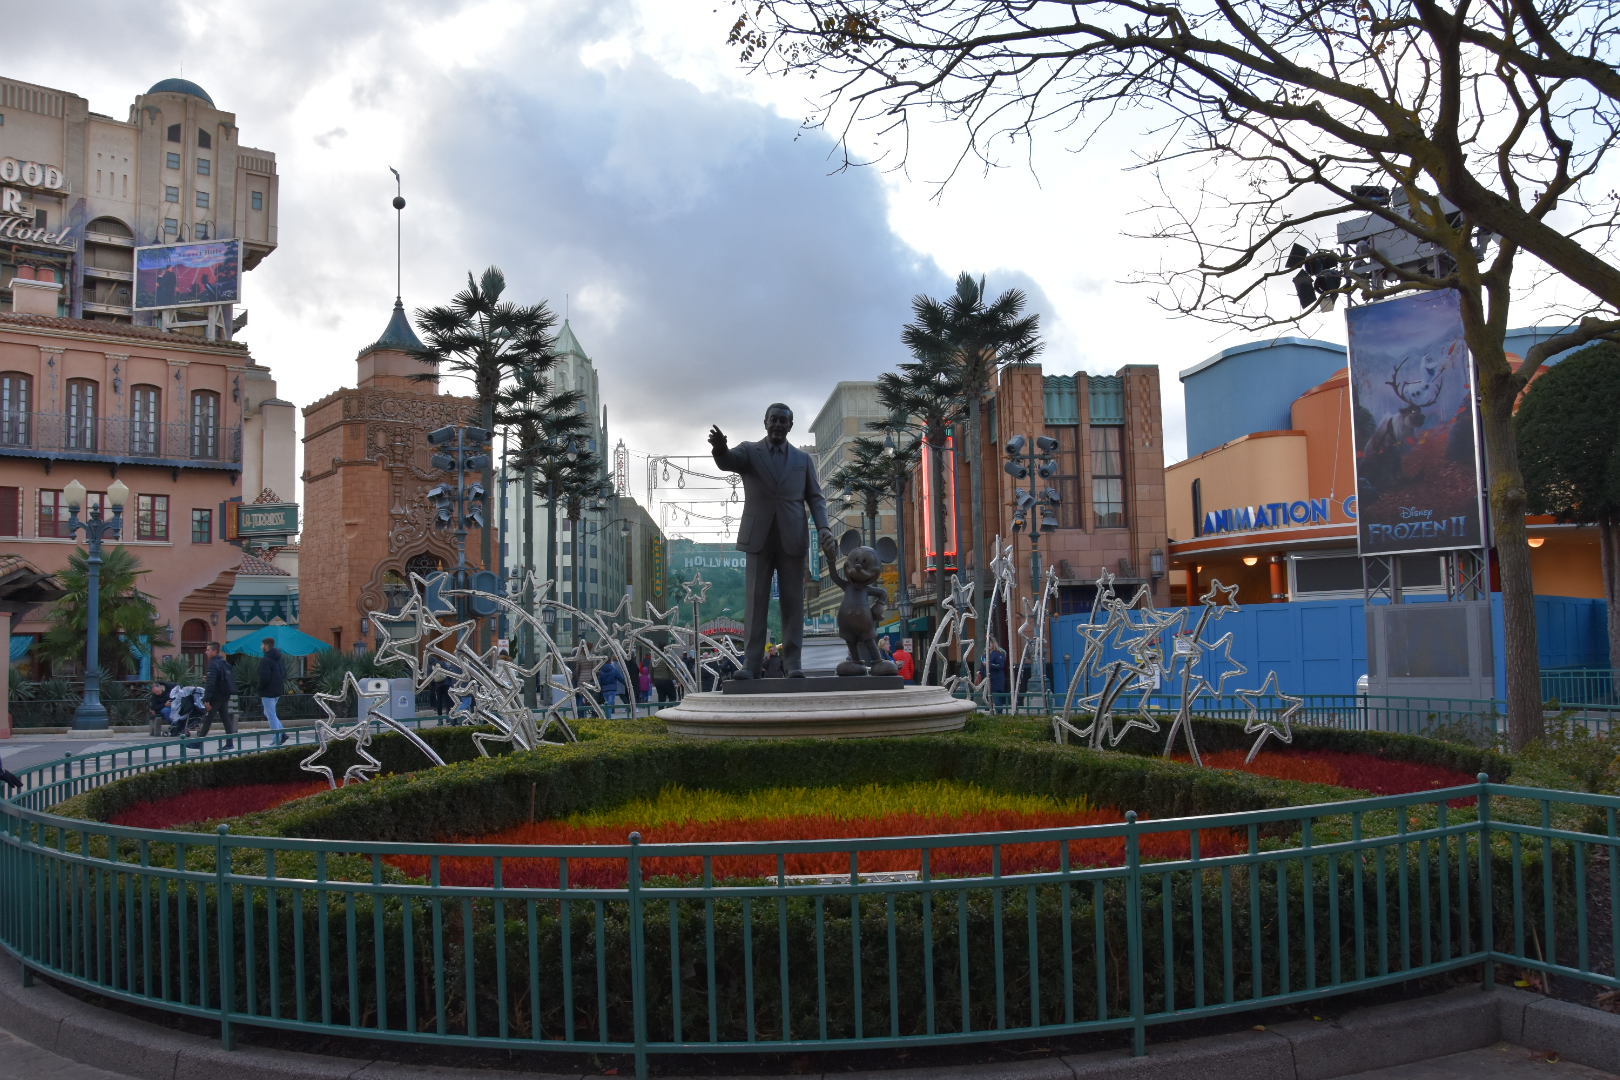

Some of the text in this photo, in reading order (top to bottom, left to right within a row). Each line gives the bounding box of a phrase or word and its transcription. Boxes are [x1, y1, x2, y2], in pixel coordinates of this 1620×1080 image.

[0, 157, 63, 190] OOD
[0, 216, 72, 245] Hotel
[1202, 497, 1331, 535] ANIMATION
[1399, 506, 1433, 520] Disney
[1367, 515, 1468, 545] FROZEN II
